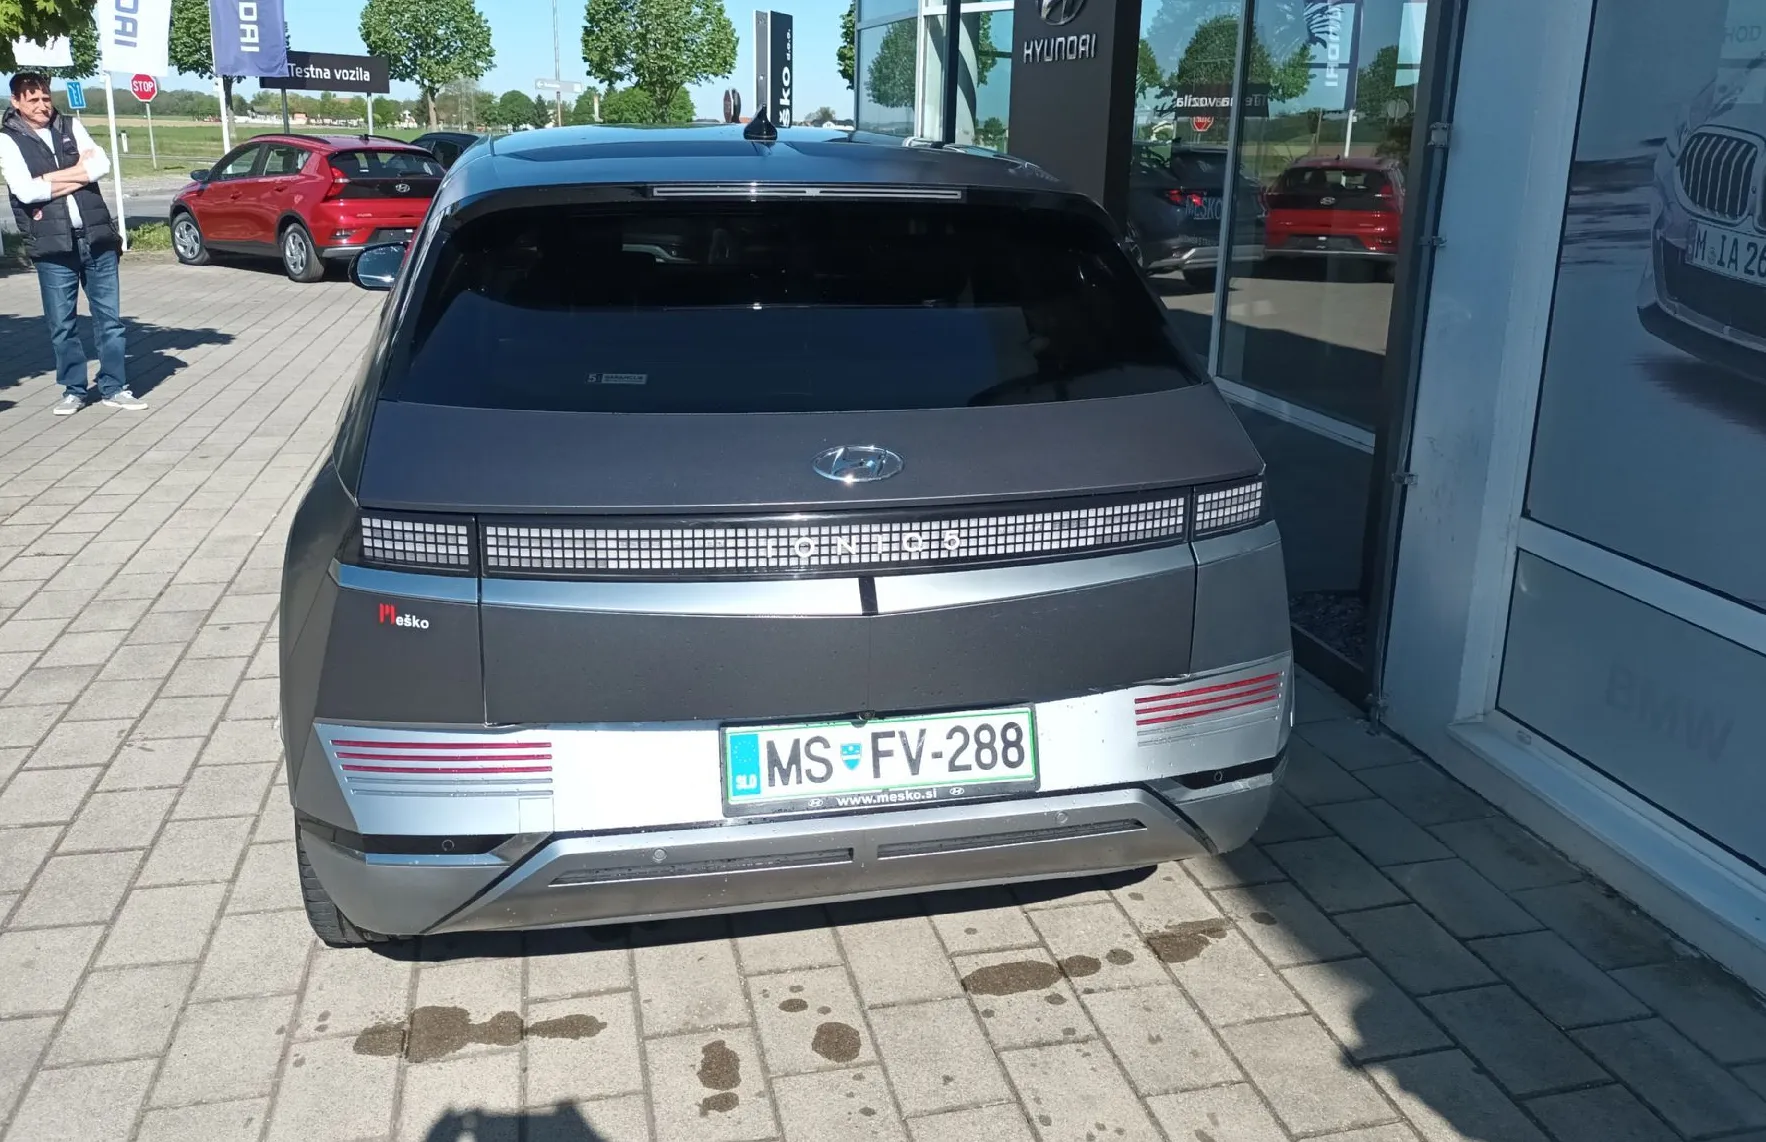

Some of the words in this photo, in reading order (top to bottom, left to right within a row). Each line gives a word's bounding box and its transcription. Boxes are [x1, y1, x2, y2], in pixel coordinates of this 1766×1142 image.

[1023, 33, 1096, 63] HYUNDAI
[287, 62, 331, 80] Testna
[334, 67, 371, 82] vozila
[132, 80, 154, 93] STOP
[779, 66, 791, 127] ško
[767, 532, 923, 558] IONIQ
[943, 529, 961, 550] 5
[378, 602, 430, 629] Meško
[766, 735, 834, 787] MS
[871, 721, 1026, 778] FV-288
[837, 788, 937, 806] www.mesko.si
